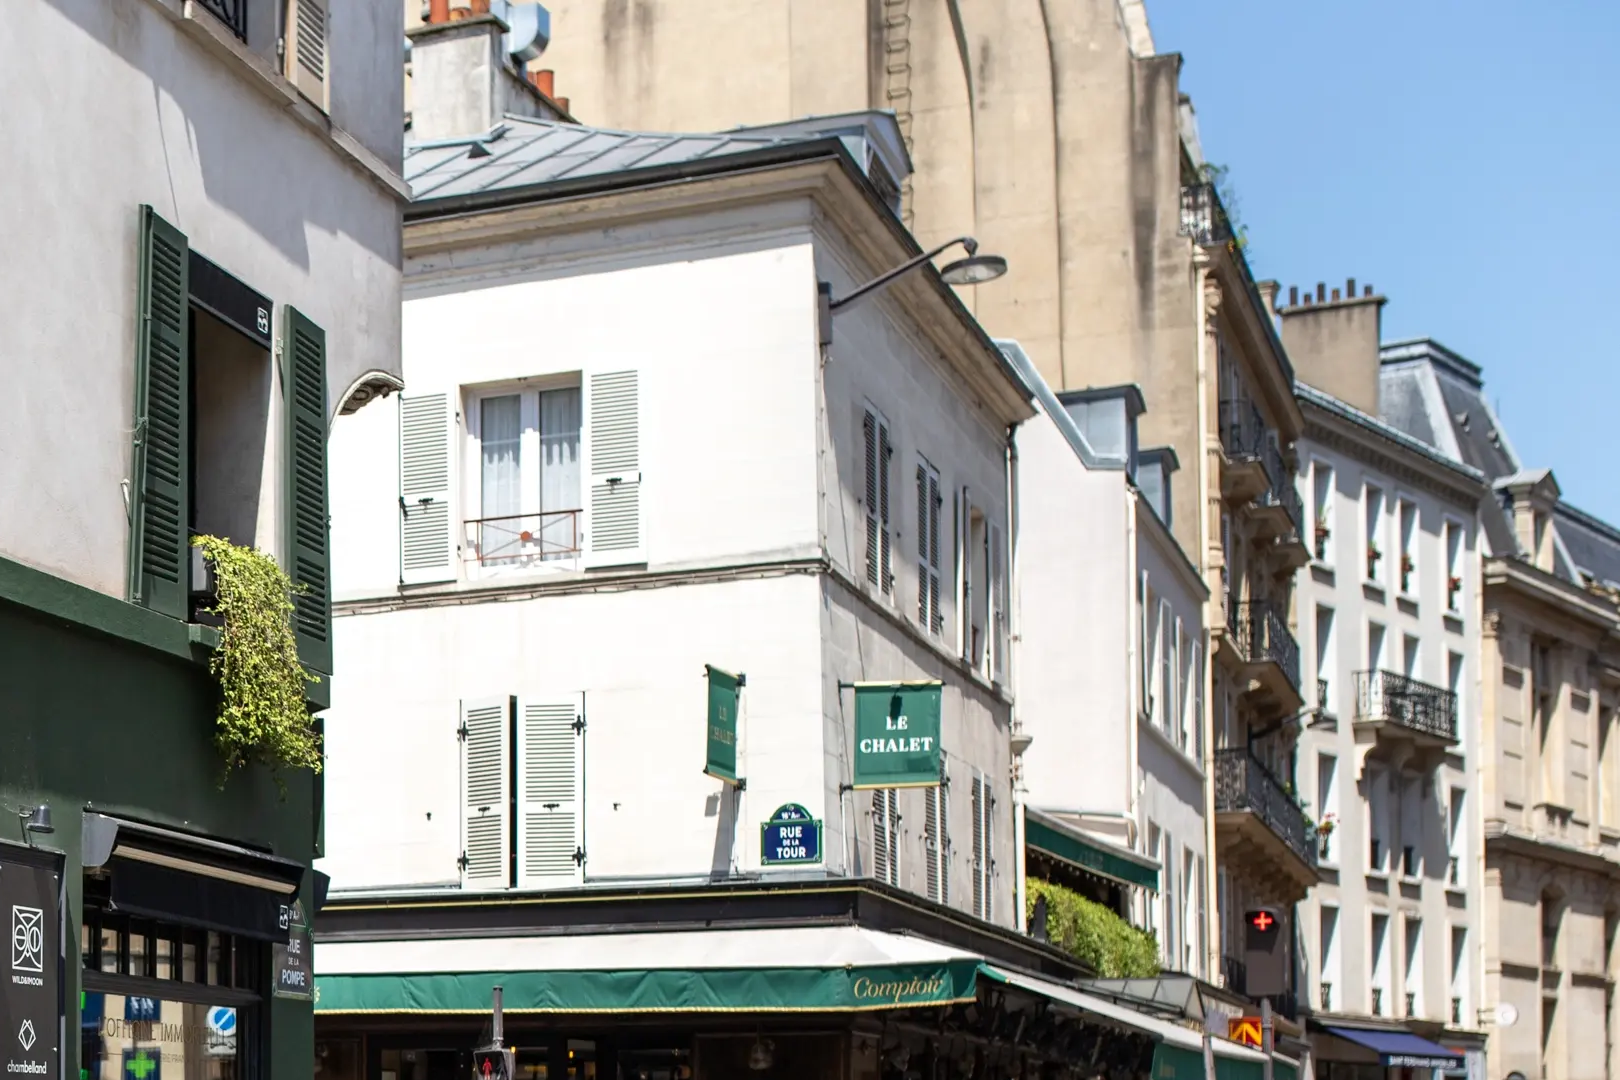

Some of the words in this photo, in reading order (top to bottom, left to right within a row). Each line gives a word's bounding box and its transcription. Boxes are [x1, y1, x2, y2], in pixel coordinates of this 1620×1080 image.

[885, 715, 908, 731] LE
[859, 736, 934, 754] CHALET
[779, 825, 803, 839] RUE
[775, 846, 807, 859] TOUR
[281, 969, 305, 986] POMPE
[854, 976, 944, 1003] Comptoir
[7, 1059, 47, 1074] chambelland
